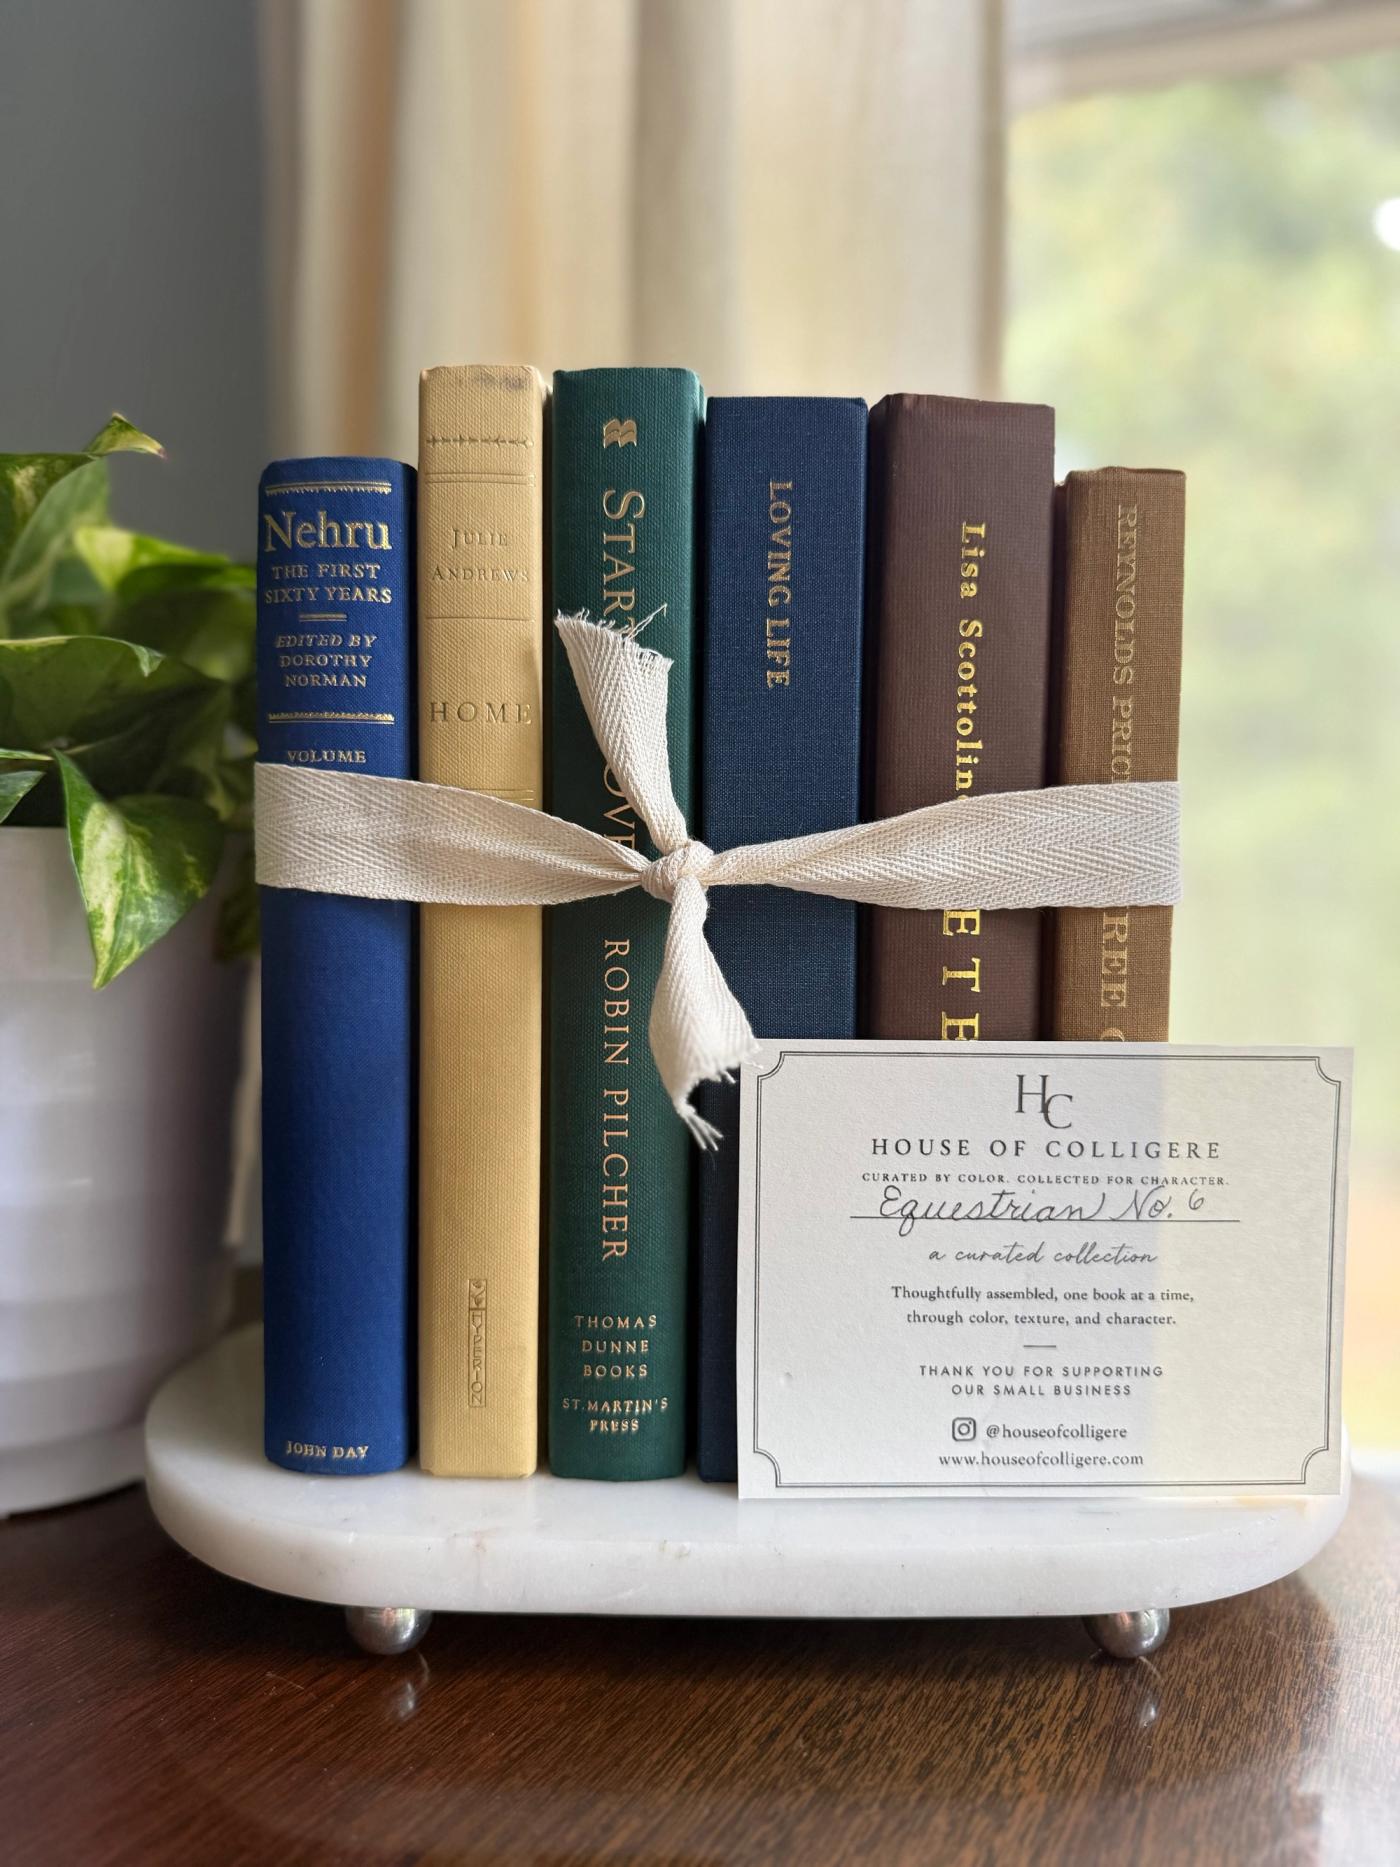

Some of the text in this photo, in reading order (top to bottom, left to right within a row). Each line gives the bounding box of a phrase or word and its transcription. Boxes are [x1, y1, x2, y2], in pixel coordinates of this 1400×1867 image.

[264, 510, 392, 552] Nehru
[452, 528, 508, 549] JULIE
[271, 562, 381, 580] THE FIRST
[431, 566, 530, 583] ANDREWS
[766, 480, 793, 689] LOVING LIFE
[264, 585, 393, 604] SIXTY YEARS
[1113, 504, 1137, 686] REYNOLDS
[276, 634, 377, 649] EDITED BY
[279, 654, 373, 668] DOROTHY
[955, 521, 986, 799] Lisa Scottolin
[284, 674, 367, 688] NORMAN
[429, 702, 532, 725] HOME
[1111, 695, 1134, 783] PRIC
[287, 750, 367, 763] VOLUME
[1100, 905, 1128, 1007] REE
[601, 939, 630, 1261] ROBIN PILCHER
[871, 1138, 1221, 1159] HOUSE OF COLLIGERE
[862, 1172, 928, 1183] CURATED
[935, 1174, 951, 1183] BY
[1017, 1175, 1100, 1185] COLLECTED
[1107, 1175, 1133, 1185] FOR
[1140, 1175, 1230, 1186] CHARACTER.
[879, 1184, 1205, 1238] Equestrian No. 6
[928, 1241, 1159, 1266] a curated collection
[891, 1285, 1195, 1303] Thoughtfully assembled, one book at a time,
[574, 1314, 657, 1329] THOMAS
[906, 1309, 1177, 1327] through color, texture, and character.
[582, 1339, 650, 1354] DUNNE
[583, 1363, 648, 1378] BOOKS
[919, 1364, 1164, 1378] THANK YOU FOR SUPPORTING
[951, 1383, 1131, 1396] OUR SMALL BUSINESS
[589, 1418, 640, 1433] PRESS
[985, 1423, 1128, 1441] @houseofcolligere
[286, 1440, 369, 1459] JOHN DAY
[938, 1450, 1144, 1468] www.houseofcolligere.com
